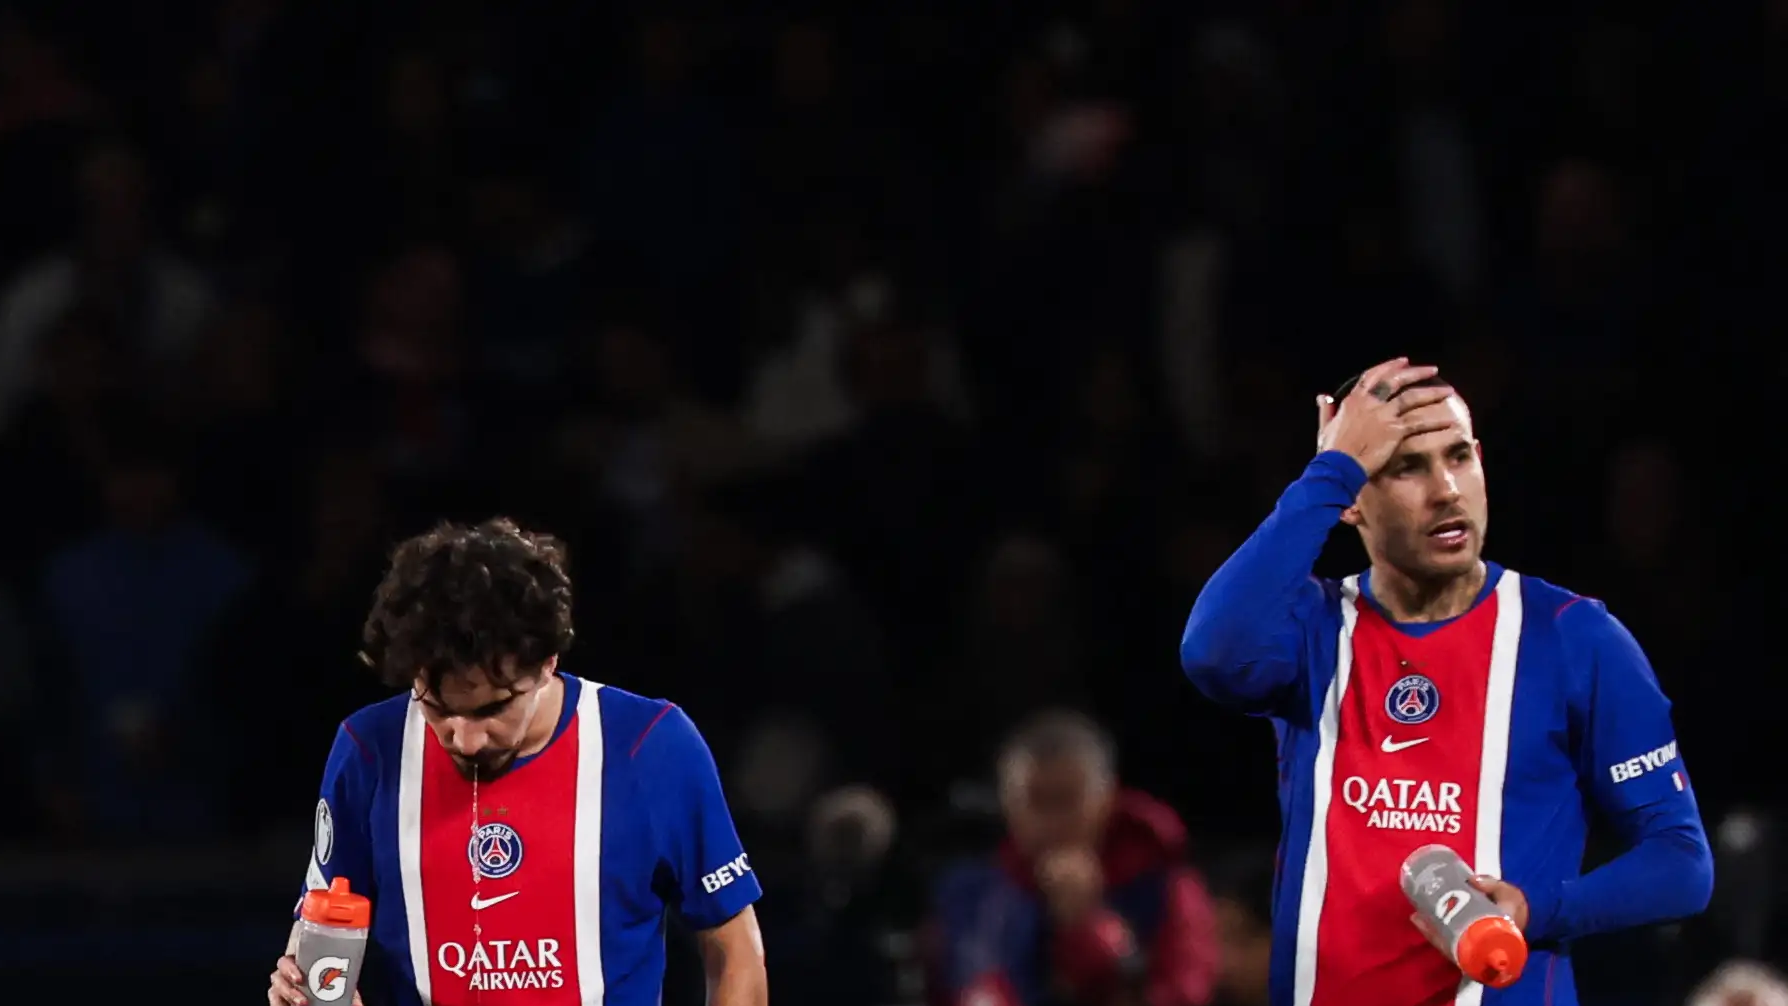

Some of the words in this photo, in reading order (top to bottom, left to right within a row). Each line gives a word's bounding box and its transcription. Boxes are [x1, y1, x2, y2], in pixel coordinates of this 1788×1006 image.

[1609, 739, 1677, 783] BEYON
[1342, 775, 1462, 814] QATAR
[477, 825, 514, 841] PARIS
[1366, 809, 1461, 834] AIRWAYS
[437, 938, 563, 978] QATAR
[308, 956, 351, 1002] G
[468, 969, 564, 991] AIRWAYS
